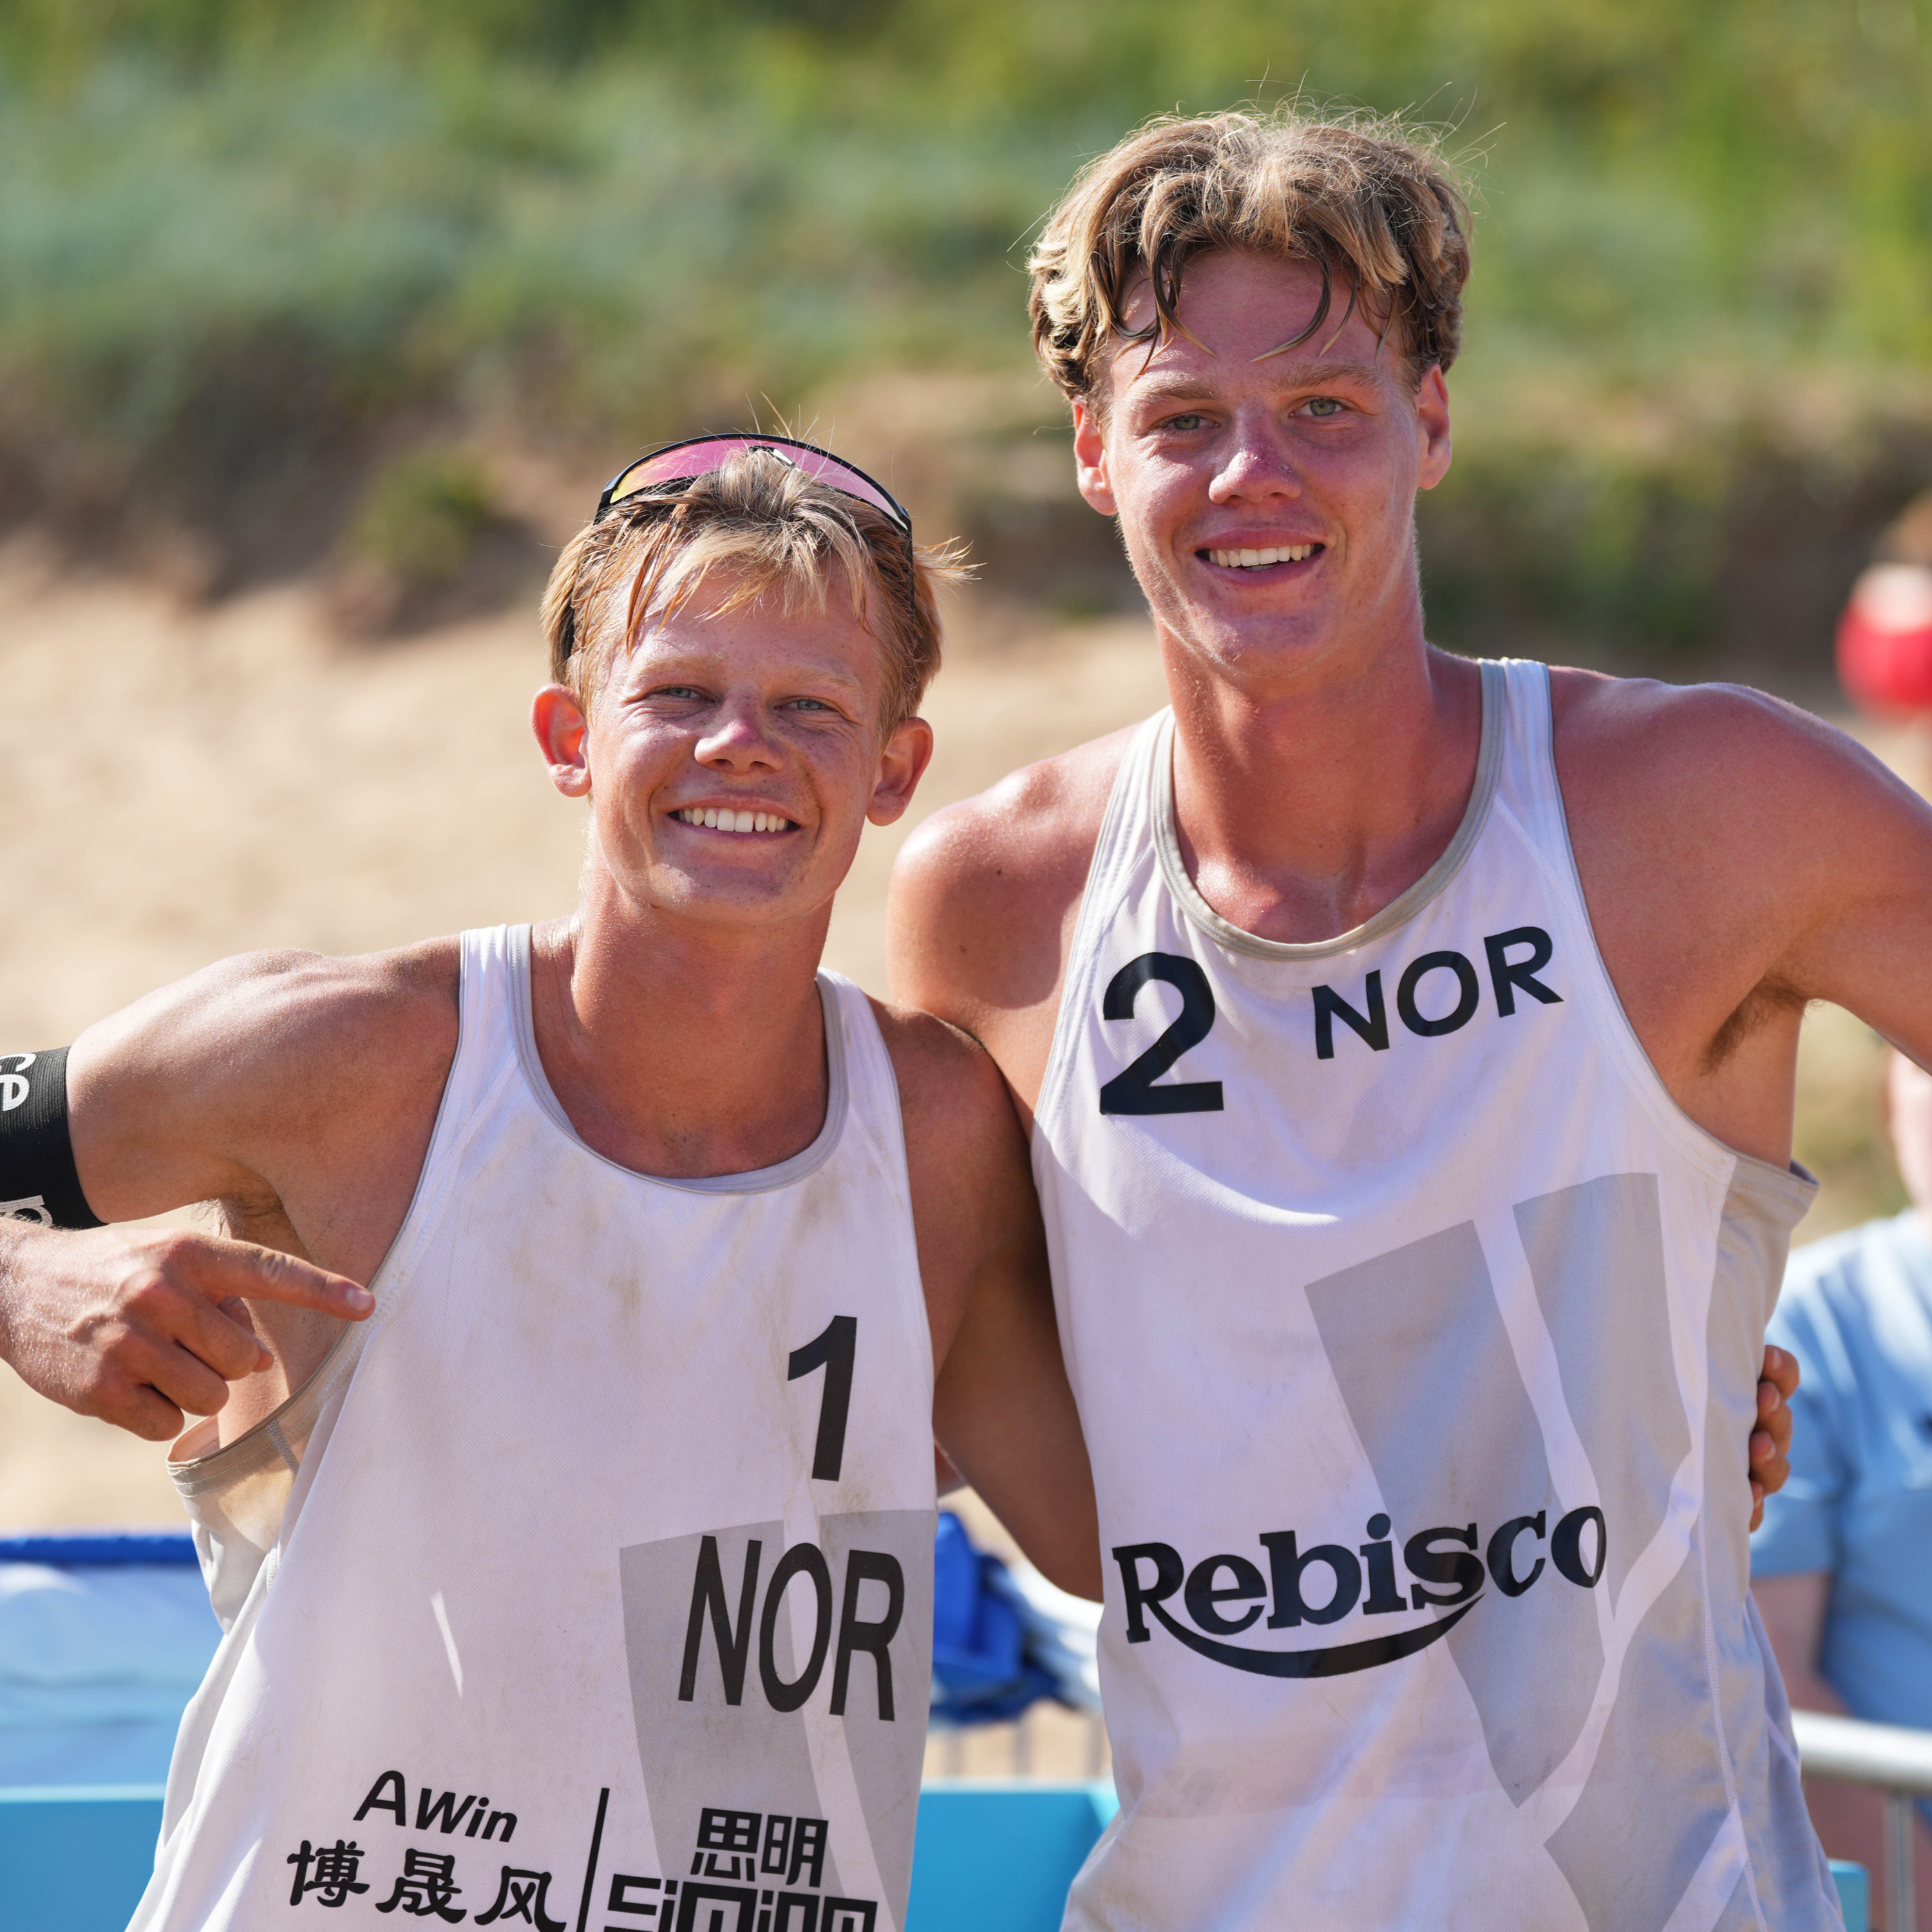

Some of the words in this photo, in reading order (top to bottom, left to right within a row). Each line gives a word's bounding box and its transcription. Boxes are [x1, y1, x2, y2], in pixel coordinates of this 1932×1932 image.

[1099, 951, 1224, 1115] 2
[1311, 926, 1564, 1060] NOR
[788, 1315, 857, 1482] 1
[677, 1535, 905, 1721] NOR
[1112, 1506, 1607, 1678] Rebisco
[353, 1770, 518, 1842] AWin
[690, 1807, 829, 1888] 思明
[287, 1839, 567, 1932] 博晟风
